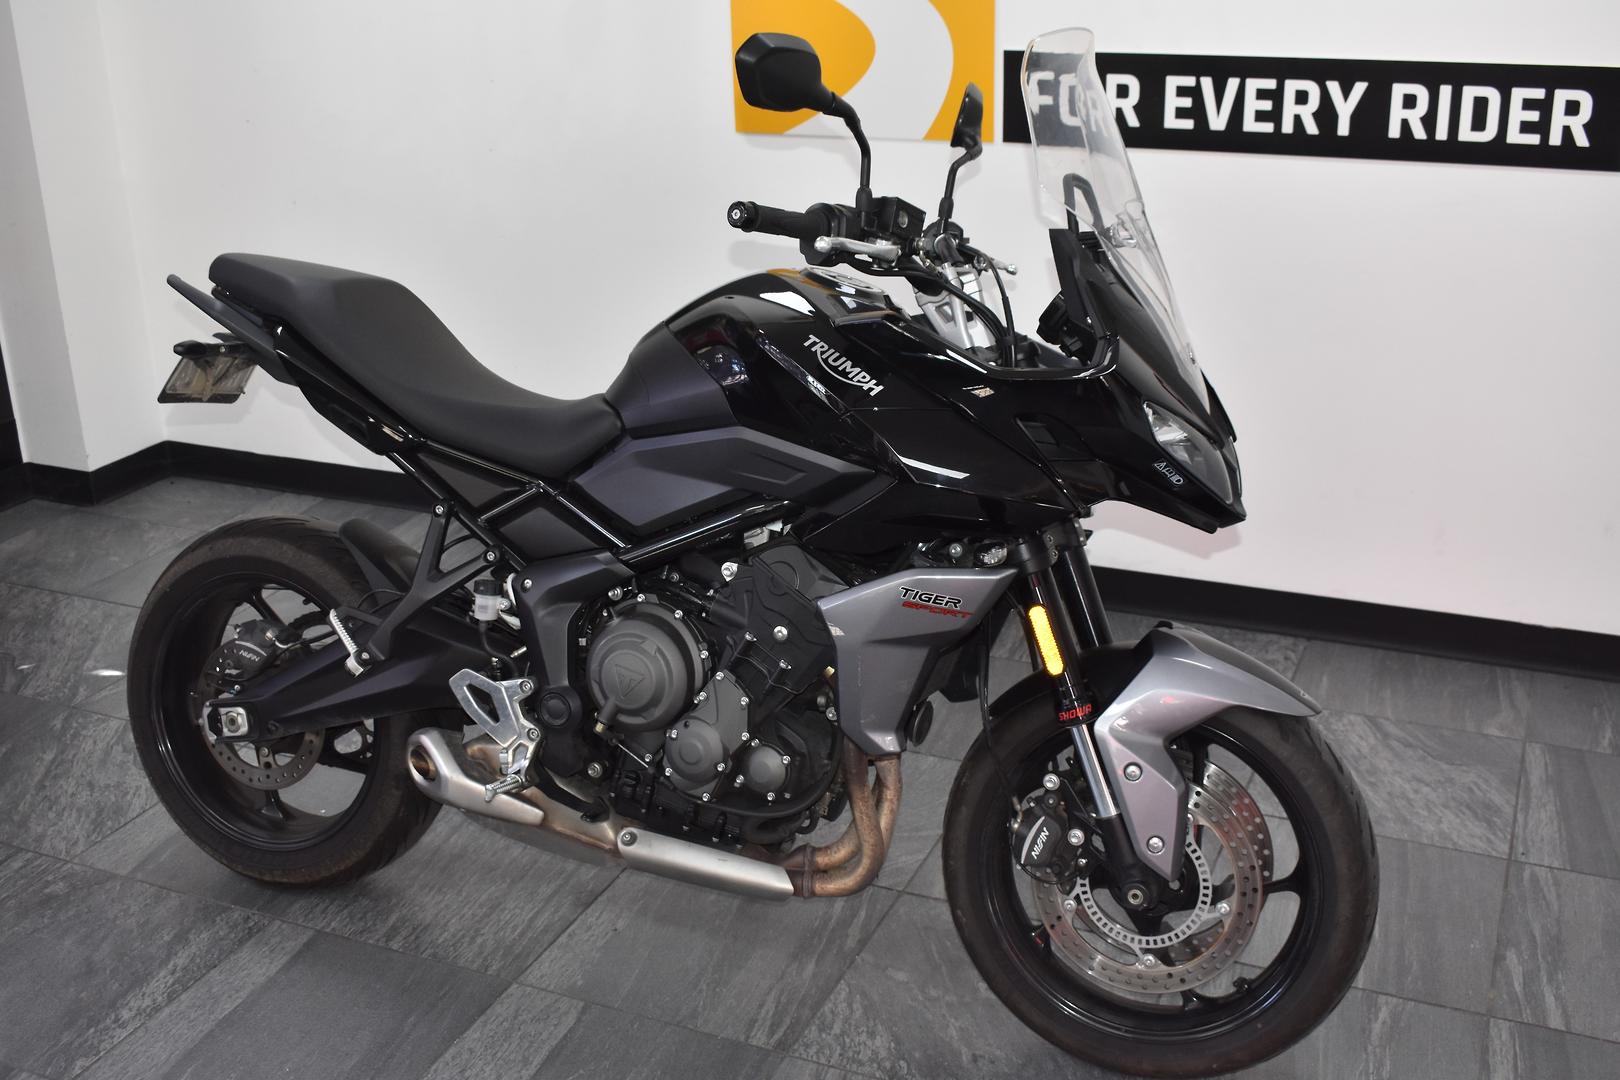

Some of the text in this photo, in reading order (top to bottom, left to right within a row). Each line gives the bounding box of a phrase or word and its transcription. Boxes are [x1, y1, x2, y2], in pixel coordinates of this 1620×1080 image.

[1028, 71, 1594, 147] FOR EVERY RIDER
[803, 334, 884, 396] TRIUMPH
[900, 586, 962, 609] TIGER
[1058, 703, 1092, 720] SHOWA
